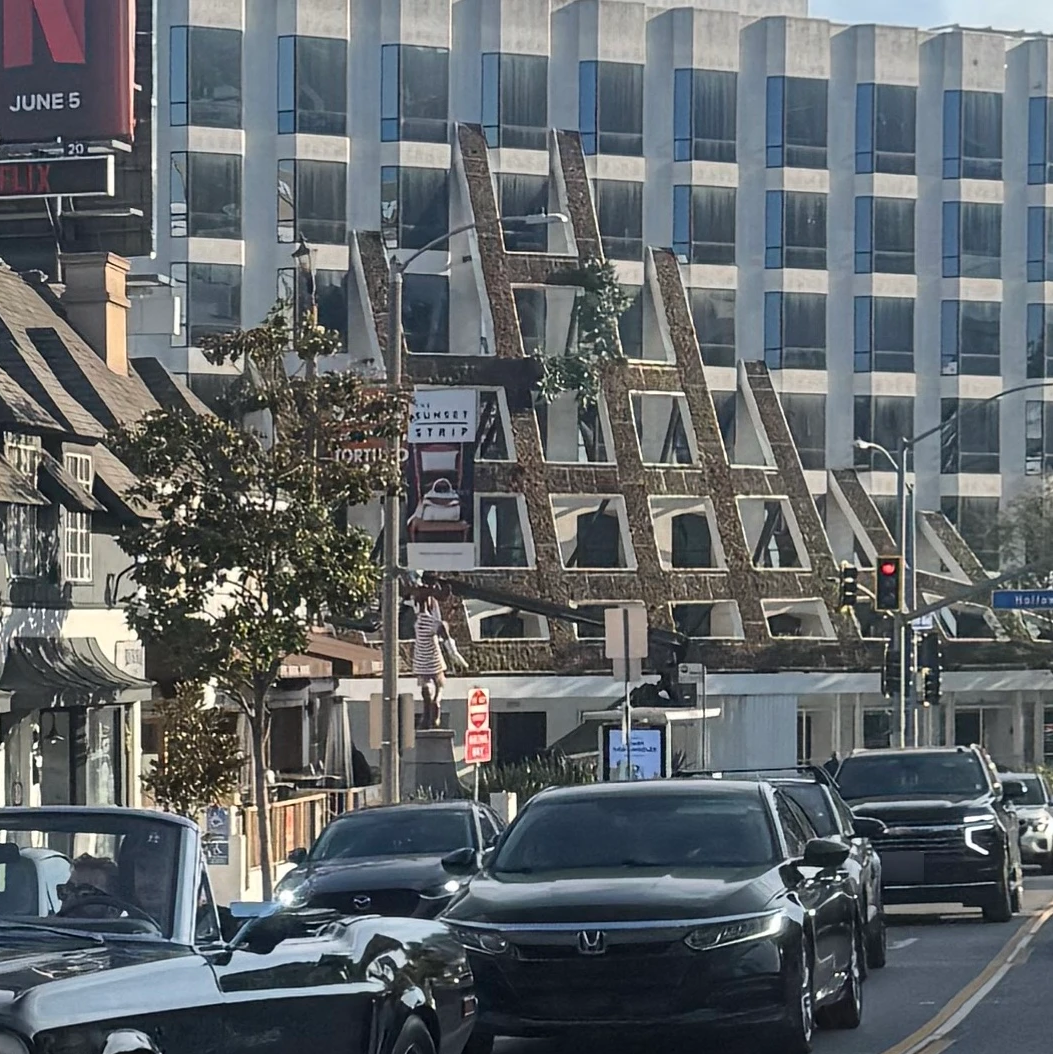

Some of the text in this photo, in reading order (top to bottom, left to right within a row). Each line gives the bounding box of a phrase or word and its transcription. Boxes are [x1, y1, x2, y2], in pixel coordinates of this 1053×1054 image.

[9, 92, 81, 112] JUNE 5
[67, 143, 84, 155] 20
[415, 410, 468, 420] SUNSET
[415, 427, 468, 437] STRIP
